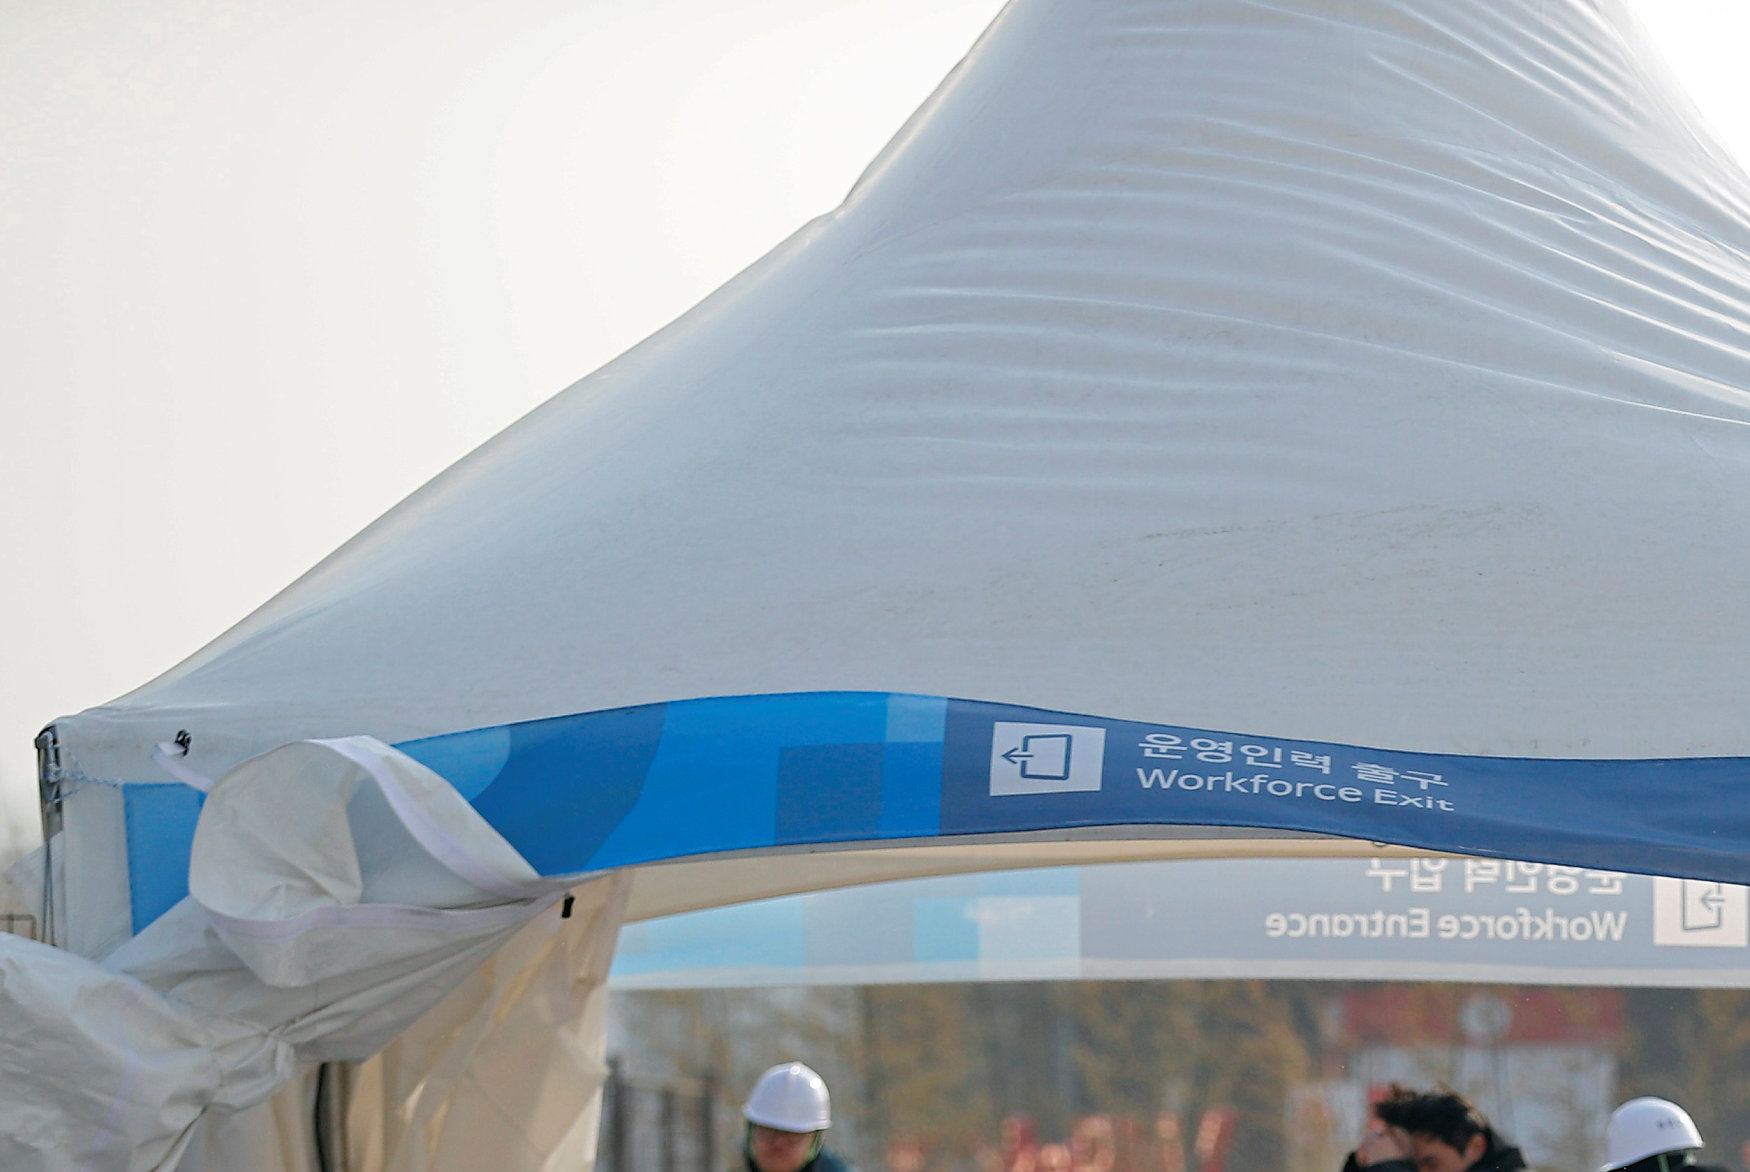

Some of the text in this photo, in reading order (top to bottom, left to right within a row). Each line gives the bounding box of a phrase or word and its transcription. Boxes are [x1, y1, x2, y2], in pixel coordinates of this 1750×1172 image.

[1138, 733, 1449, 790] 운영인력 출구
[1136, 767, 1455, 812] Workforce Exit
